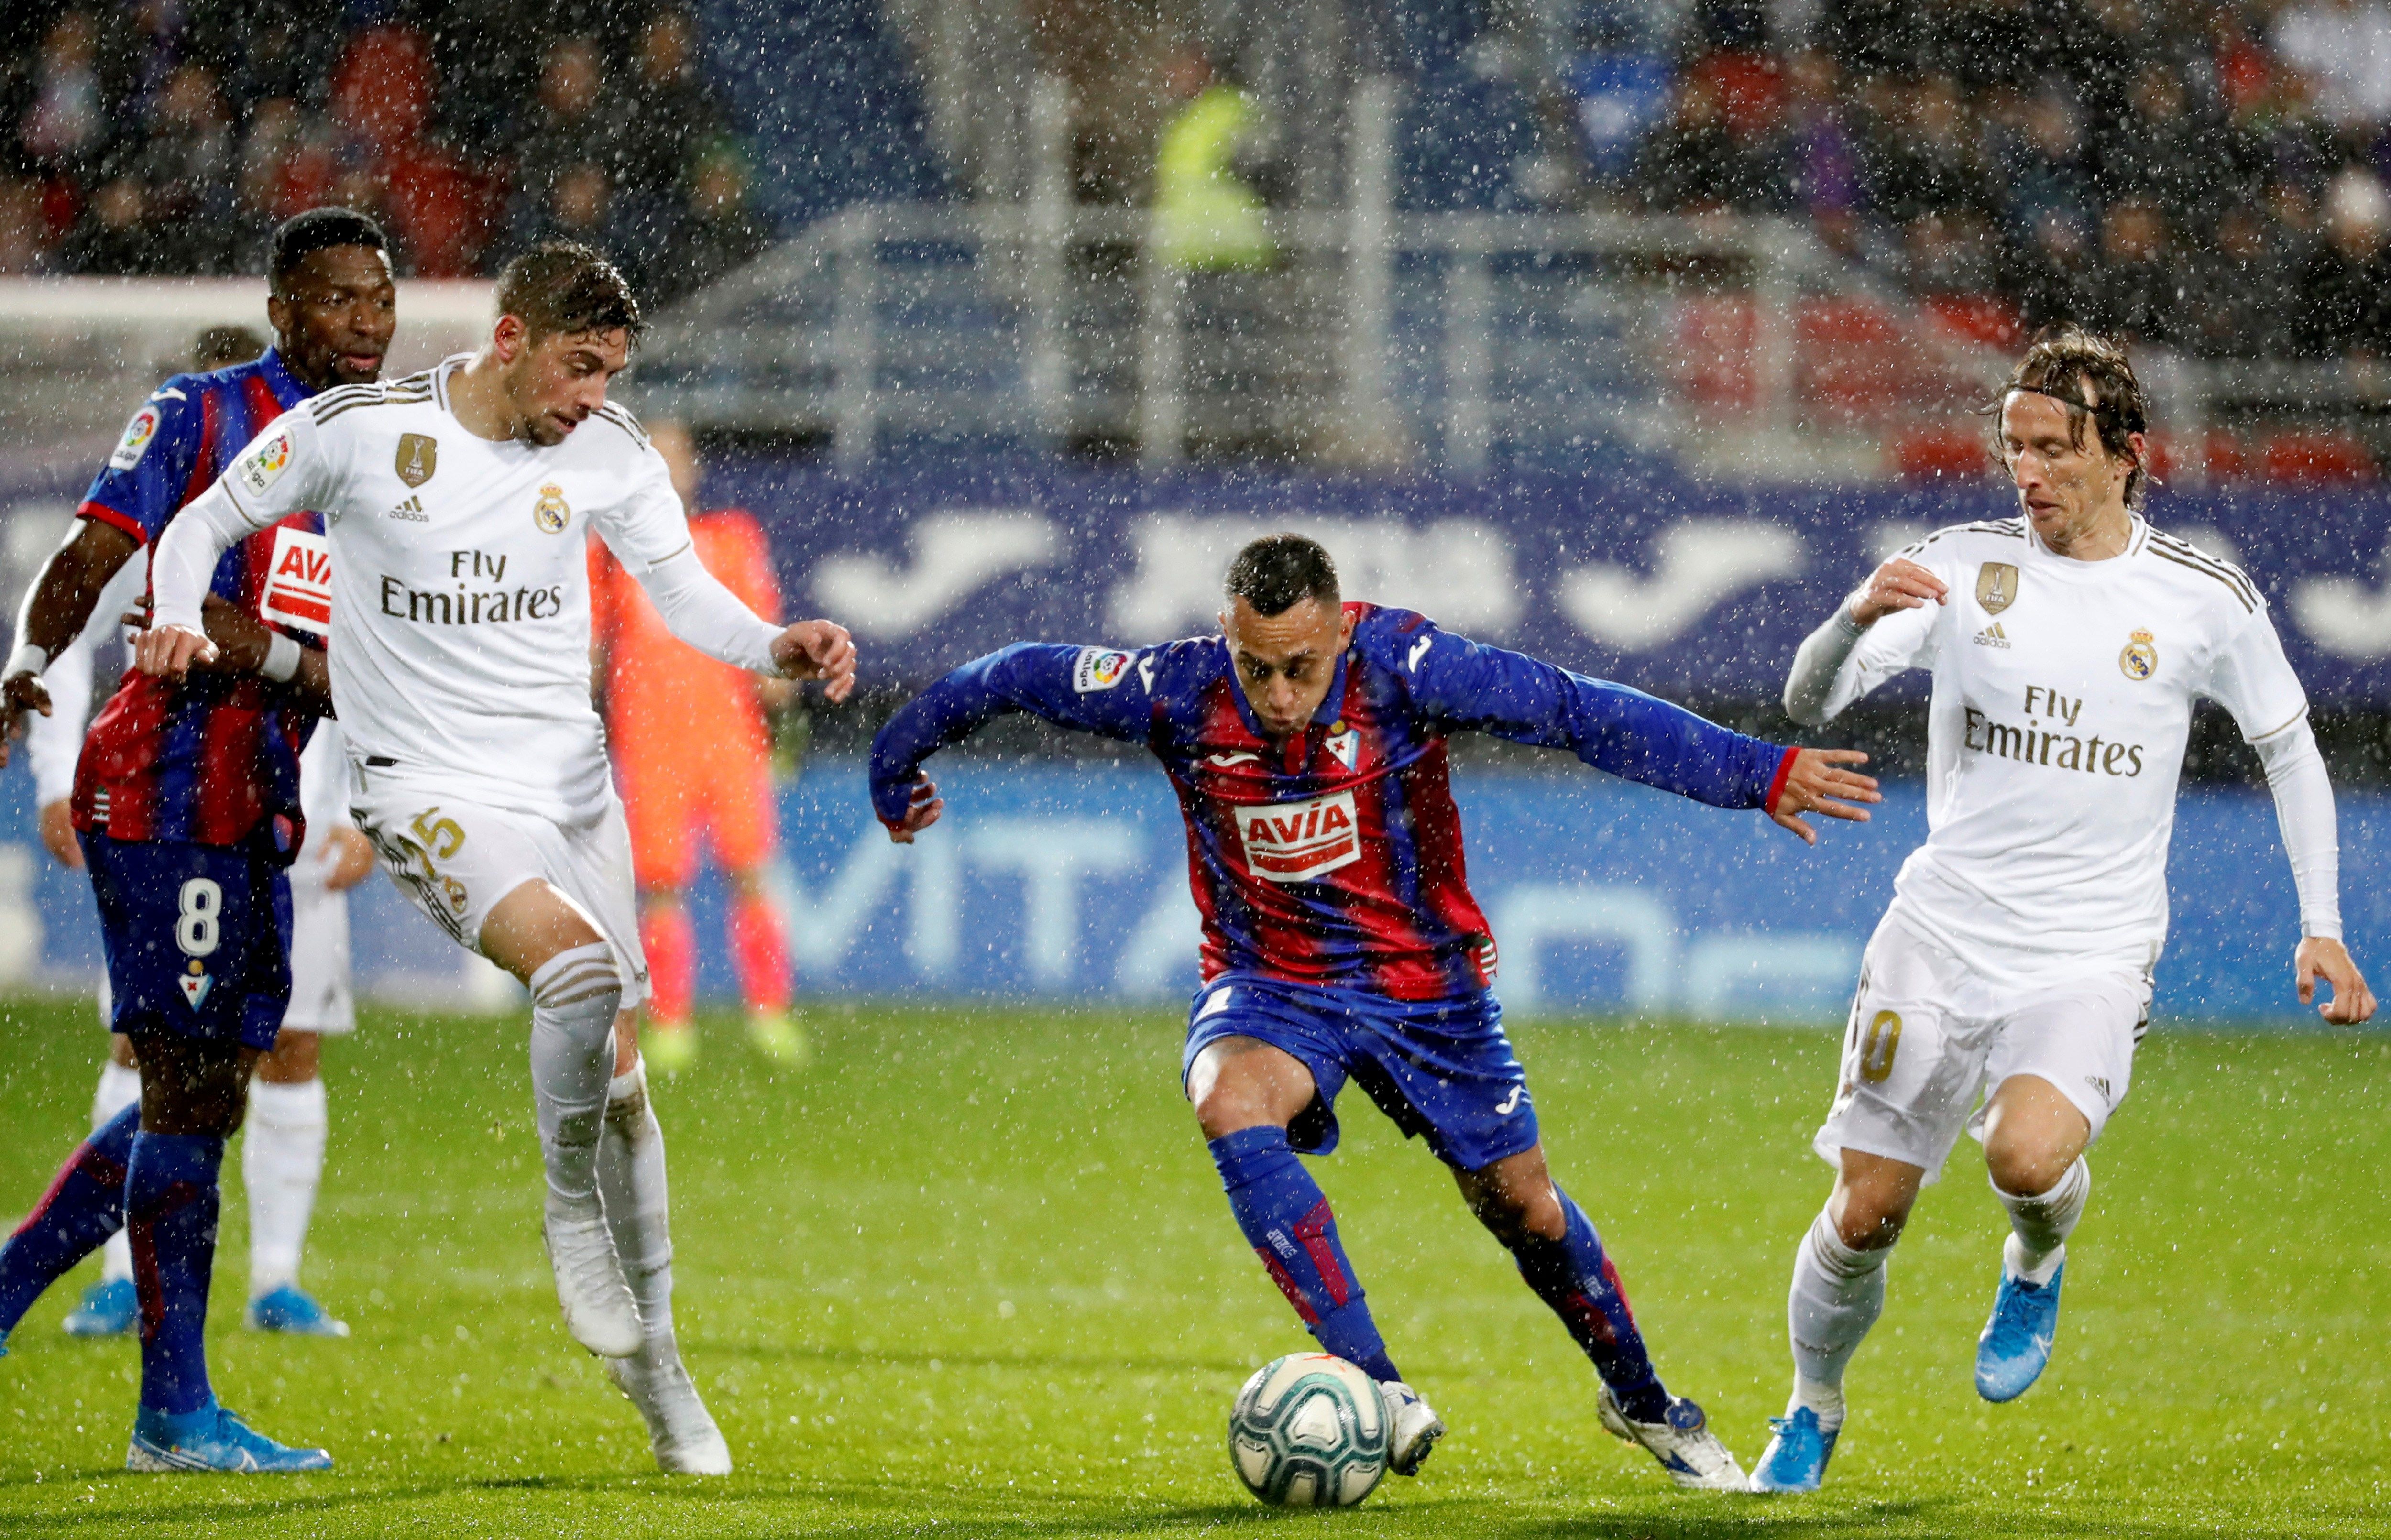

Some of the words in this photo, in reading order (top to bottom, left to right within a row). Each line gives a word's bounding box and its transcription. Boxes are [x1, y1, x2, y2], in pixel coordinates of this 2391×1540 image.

[389, 510, 429, 522] adidas
[451, 550, 507, 582] Fly
[381, 574, 561, 625] Emirates
[1985, 594, 2005, 603] FIFA
[1973, 635, 2011, 649] adidas
[1080, 649, 1097, 687] LaLiga
[2024, 684, 2082, 727] Fly
[1964, 705, 2143, 777] Emirates
[1247, 801, 1351, 844] AVÍA
[175, 877, 222, 956] 8
[1860, 1009, 1902, 1085] 0
